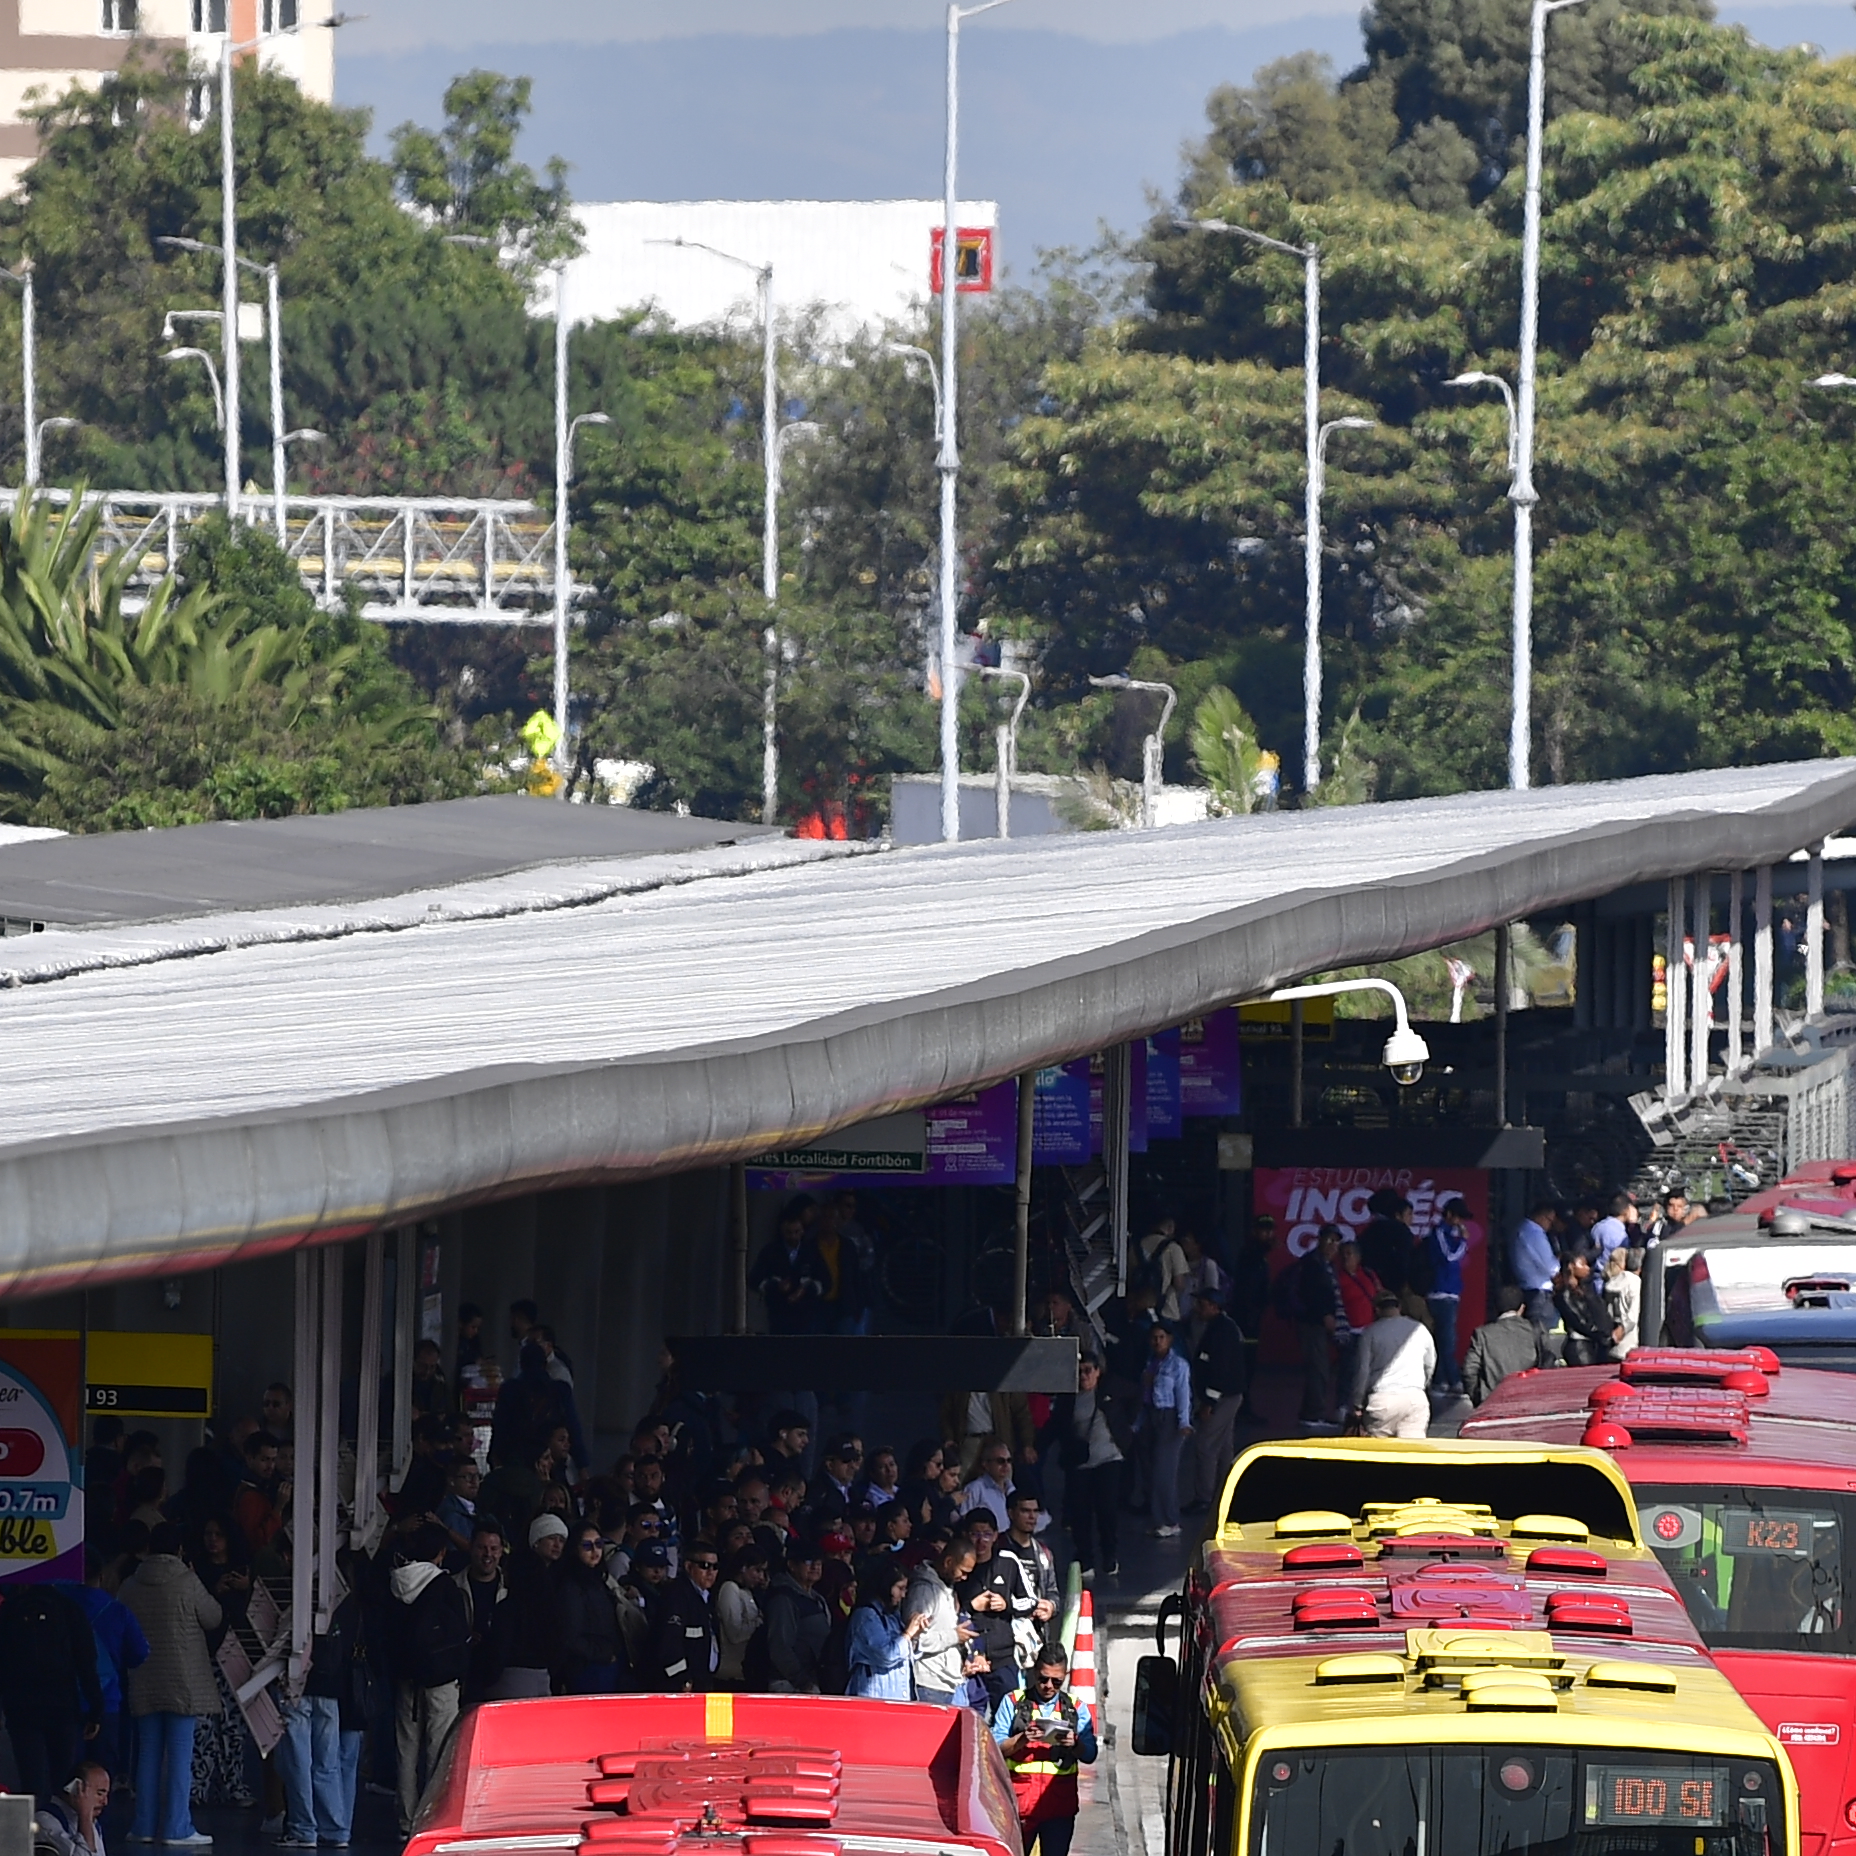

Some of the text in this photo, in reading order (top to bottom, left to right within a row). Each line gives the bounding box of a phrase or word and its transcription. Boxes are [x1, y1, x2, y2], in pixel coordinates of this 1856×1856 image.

[783, 1152, 847, 1166] Localidad
[850, 1154, 912, 1168] Fontibón
[1294, 1167, 1413, 1187] ESTUDIAR
[96, 1389, 118, 1406] 93
[1747, 1520, 1799, 1549] K23
